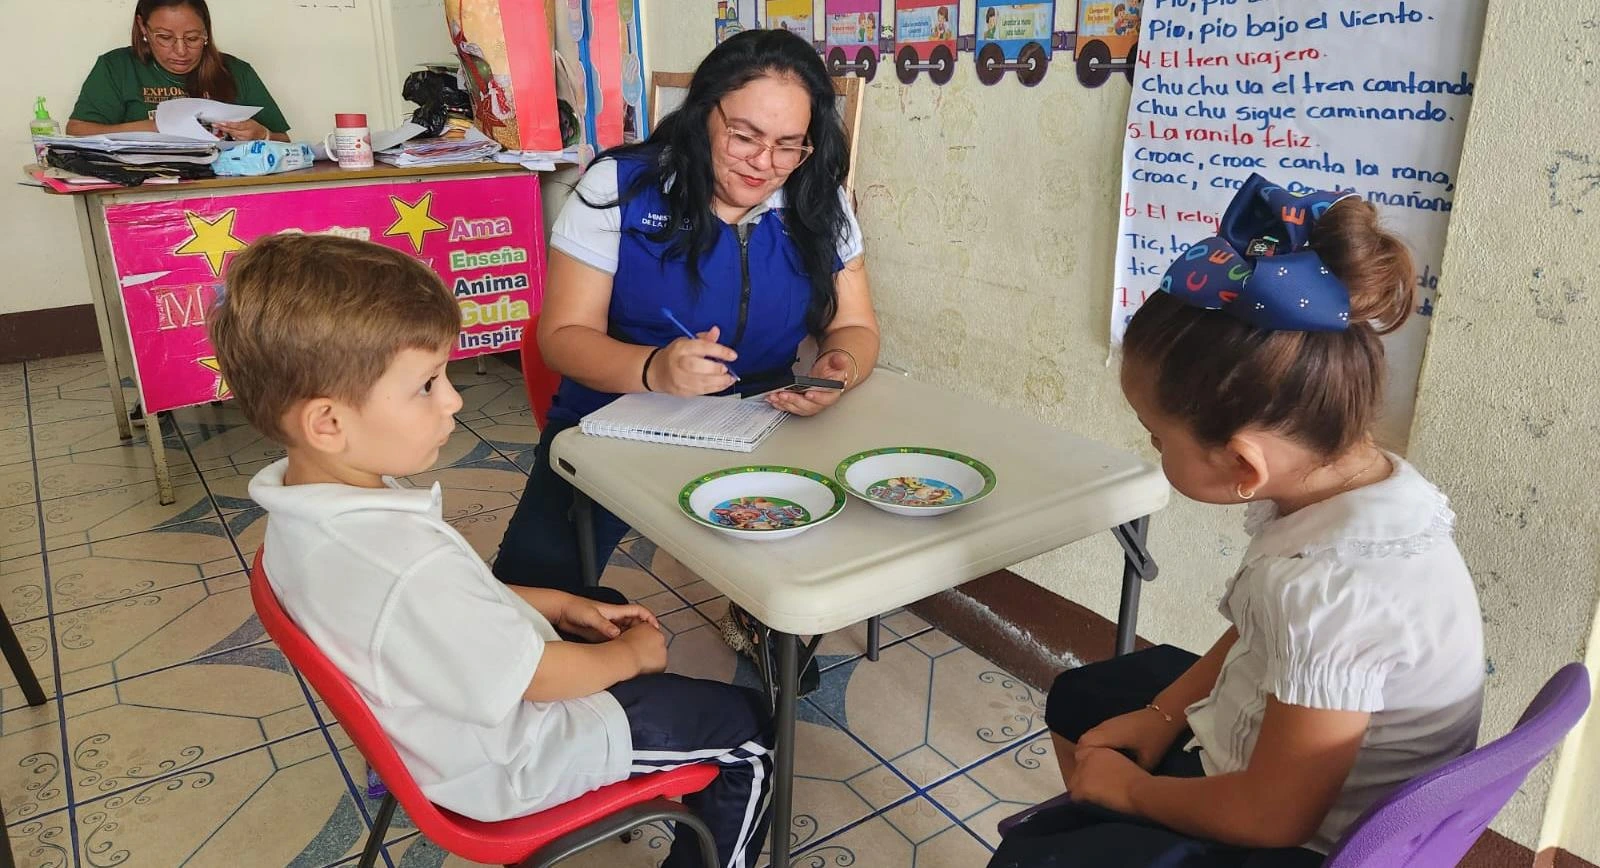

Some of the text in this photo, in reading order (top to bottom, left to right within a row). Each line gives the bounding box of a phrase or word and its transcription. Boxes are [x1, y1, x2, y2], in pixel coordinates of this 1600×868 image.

[1246, 13, 1299, 41] bajo
[1305, 12, 1328, 30] el
[1160, 50, 1178, 68] El
[1185, 48, 1229, 67] tren
[1271, 74, 1295, 94] el
[1302, 71, 1354, 94] tren
[1236, 105, 1296, 131] sigue
[1306, 99, 1454, 122] caminando.
[1150, 120, 1179, 141] La
[1209, 153, 1267, 168] croac
[1279, 151, 1345, 174] canta
[1355, 158, 1379, 176] la
[1392, 166, 1454, 192] rana,
[1209, 176, 1244, 190] cro
[1147, 203, 1165, 219] El
[450, 217, 512, 241] Ama
[1125, 232, 1164, 255] Tic,
[451, 248, 526, 270] Enseña
[455, 275, 528, 297] Anima
[459, 297, 528, 326] Guía
[460, 327, 522, 348] Inspir
